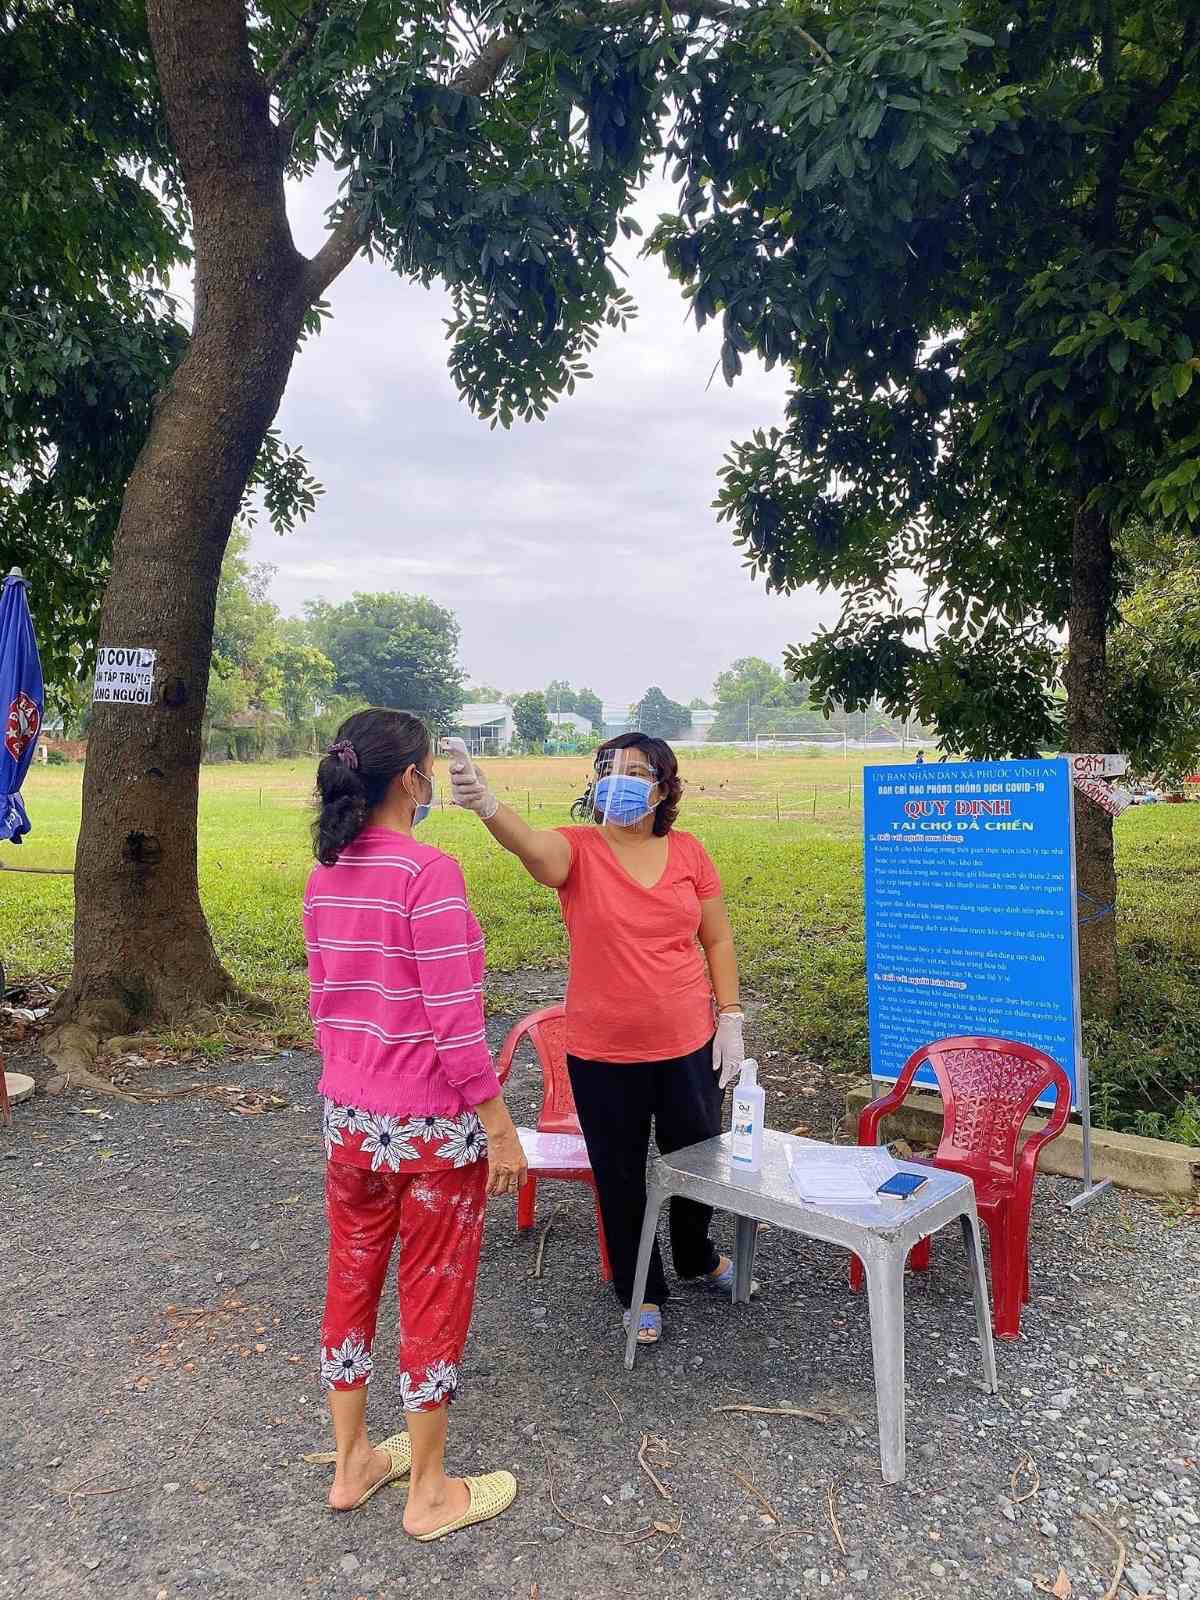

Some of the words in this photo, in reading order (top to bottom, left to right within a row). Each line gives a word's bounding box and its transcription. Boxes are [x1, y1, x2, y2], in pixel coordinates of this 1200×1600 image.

[1041, 767, 1057, 777] AN
[1005, 782, 1045, 793] COVID-19
[904, 800, 950, 820] QUY
[955, 800, 1012, 820] ĐỊNH
[920, 820, 952, 832] CHỢ
[985, 819, 1034, 831] CHIẾN
